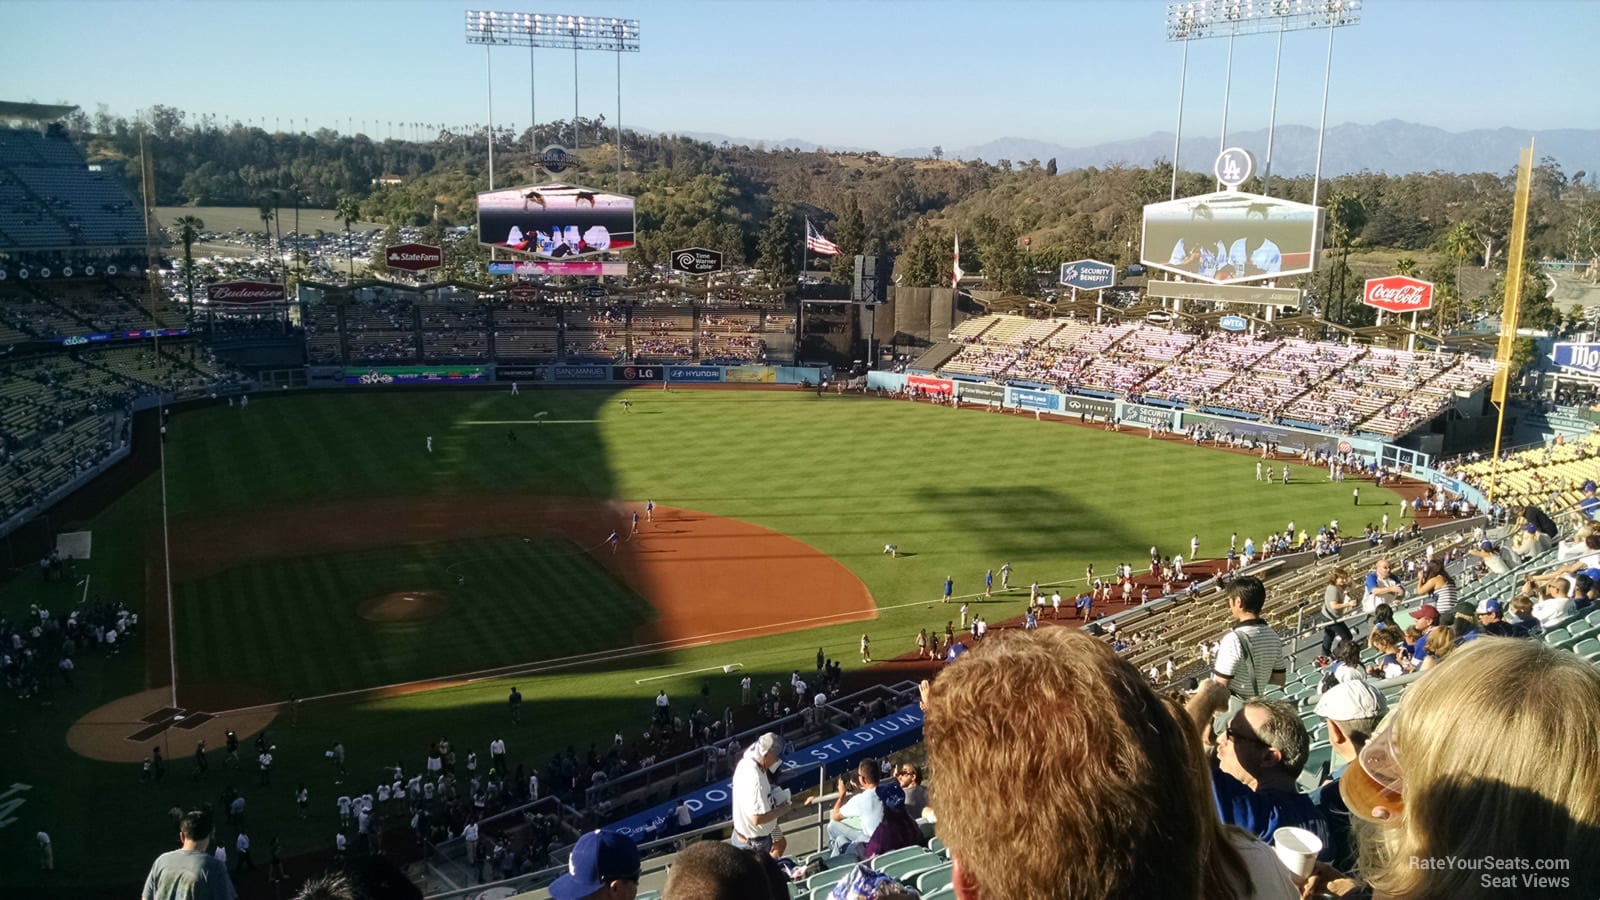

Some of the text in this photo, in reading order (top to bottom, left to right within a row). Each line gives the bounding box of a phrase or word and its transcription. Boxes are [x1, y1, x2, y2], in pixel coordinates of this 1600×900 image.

[1080, 267, 1110, 275] SECURITY
[1080, 274, 1108, 282] BENEFIT
[209, 286, 284, 300] Budweiser
[639, 369, 654, 379] LG
[685, 367, 720, 377] HYUNDAI
[1081, 403, 1113, 414] INFINITI
[1139, 407, 1172, 419] SECURITY
[810, 712, 921, 760] STADIUM
